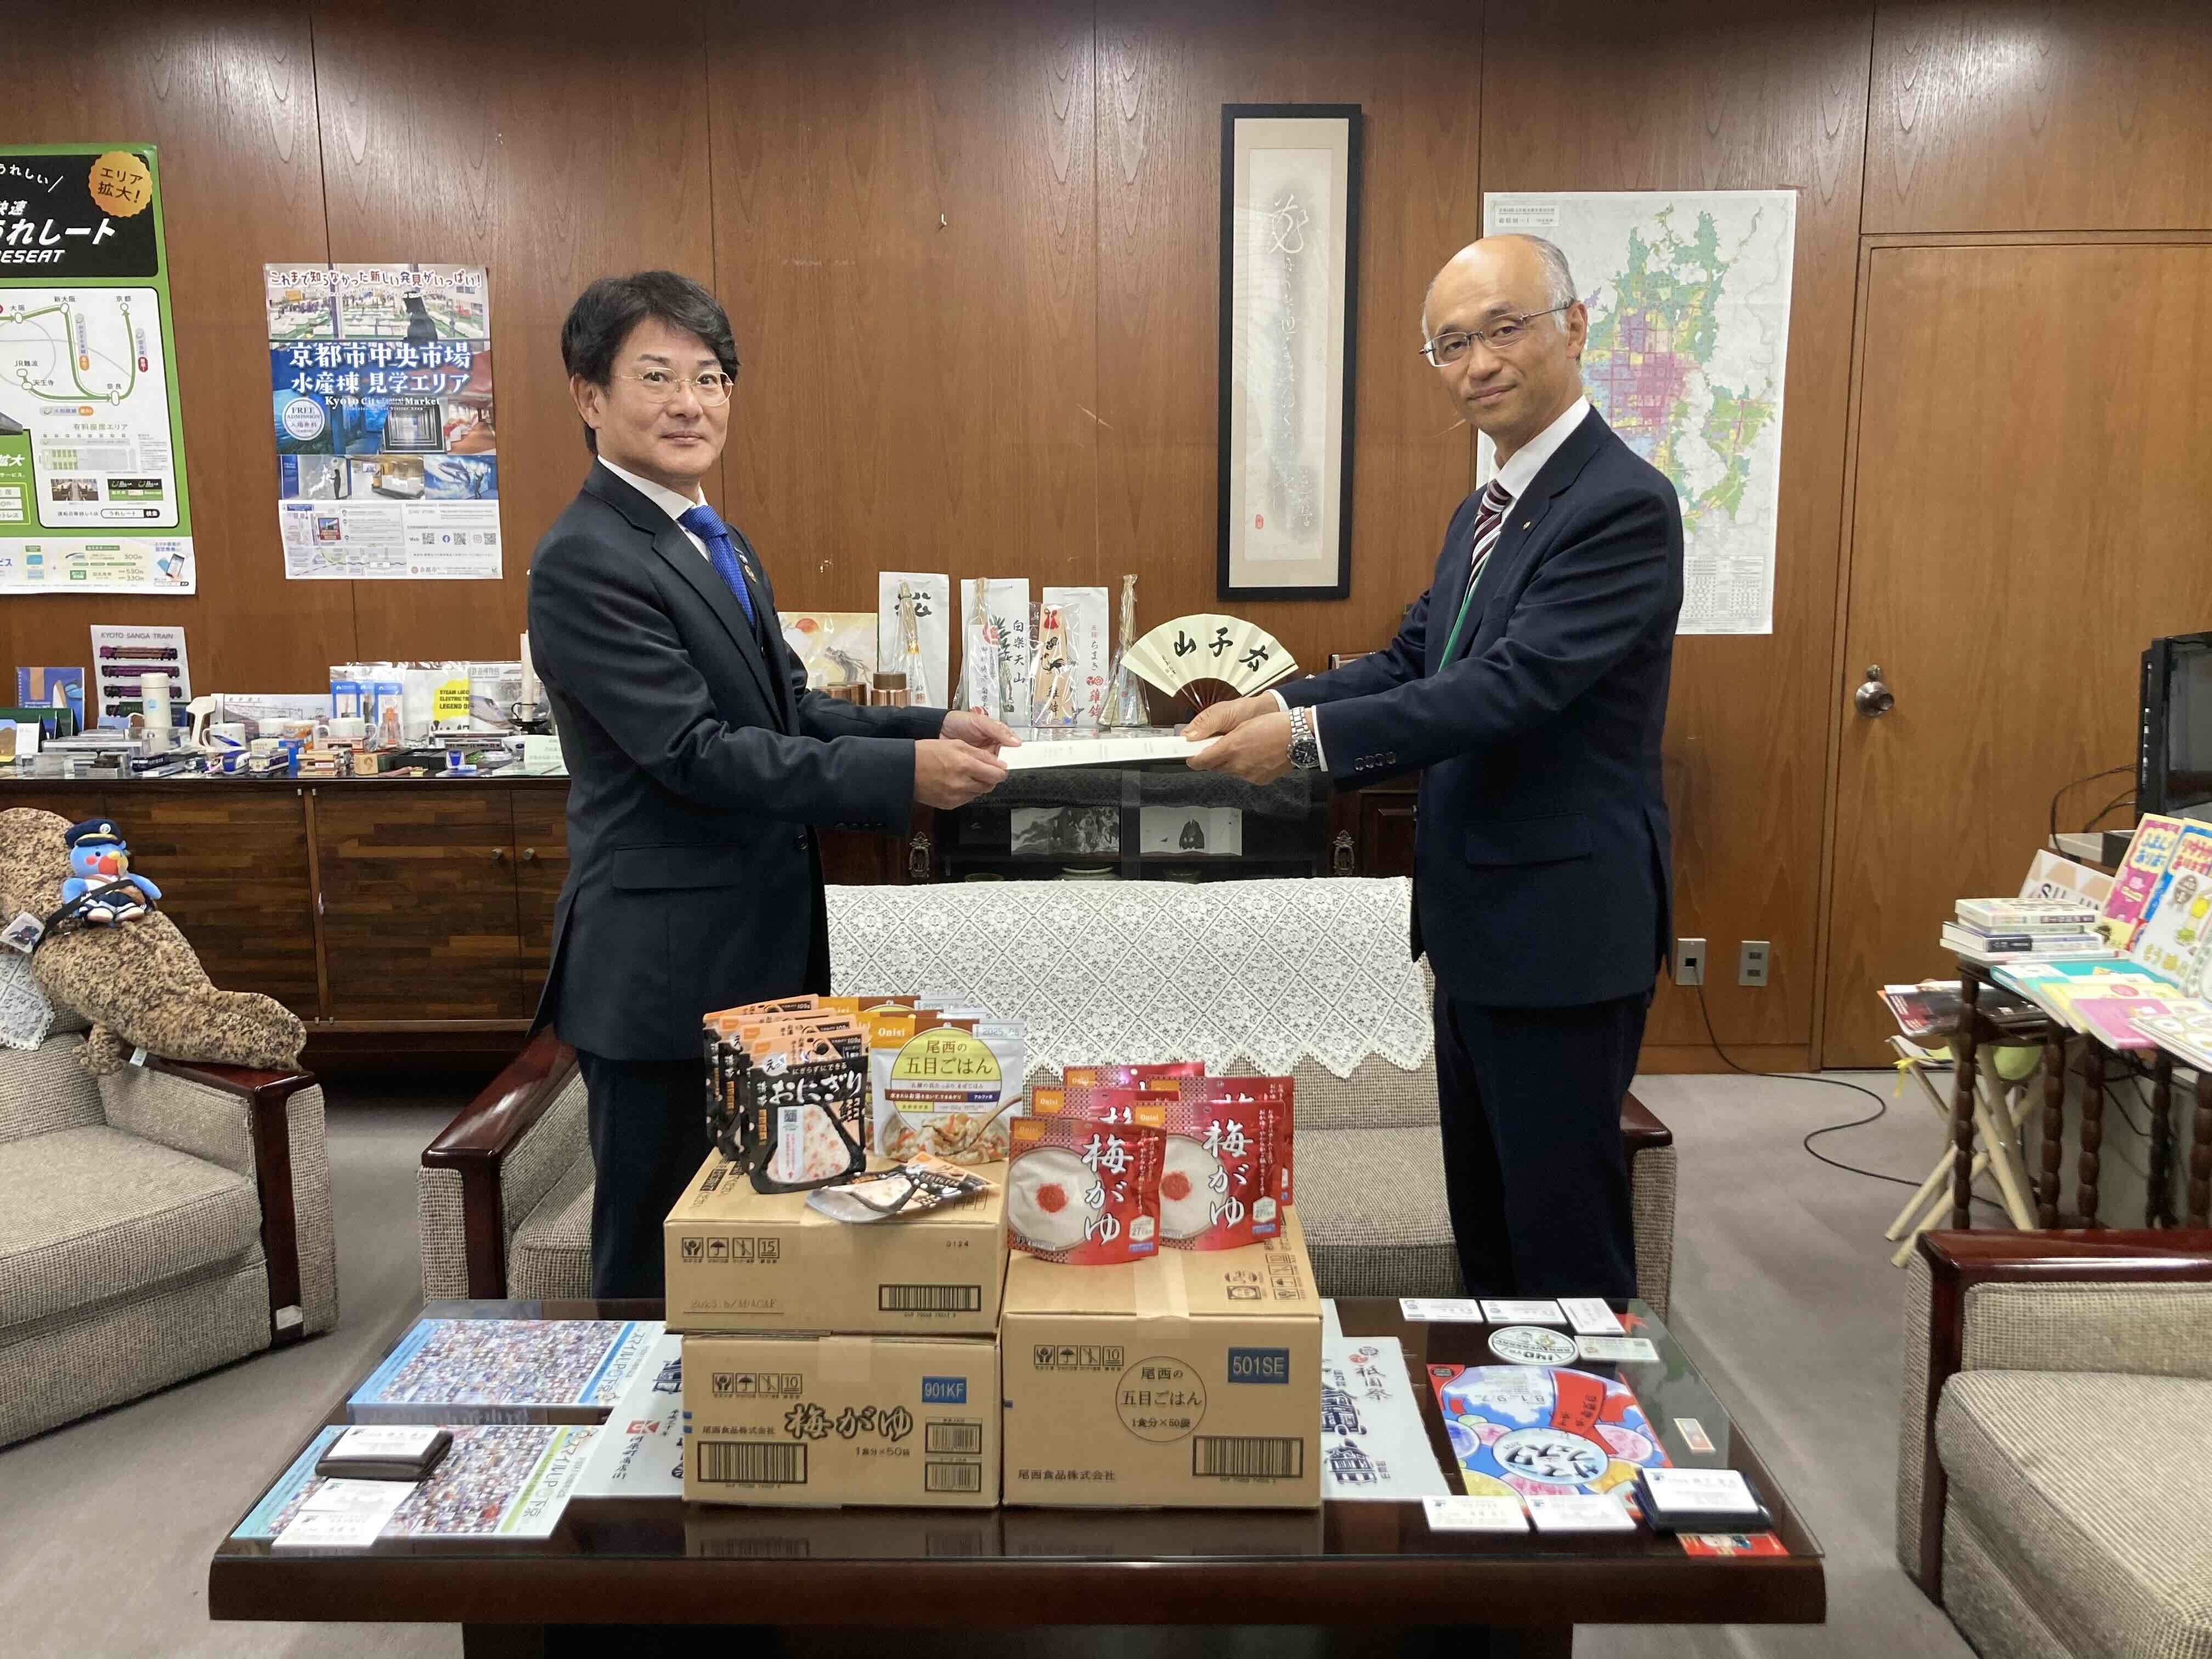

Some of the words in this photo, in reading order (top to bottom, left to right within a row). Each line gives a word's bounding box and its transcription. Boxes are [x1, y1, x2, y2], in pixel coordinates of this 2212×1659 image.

[100, 167, 143, 185] エリア
[0, 250, 66, 263] ESEAT
[289, 342, 471, 369] 京都市中央市場
[291, 373, 360, 394] 水産棟
[368, 373, 471, 394] 見学エリア
[325, 396, 359, 409] Kyoto
[361, 396, 381, 407] City
[405, 396, 440, 405] Market
[877, 1026, 905, 1036] Onisi
[926, 1040, 967, 1054] 尾西の
[904, 1057, 992, 1075] 五目ごはん
[769, 1070, 862, 1104] おにぎり
[1201, 1119, 1254, 1229] 梅がゆ
[1080, 1132, 1135, 1246] 梅がゆ
[761, 1241, 775, 1252] 15
[1106, 1348, 1120, 1360] 10
[1232, 1356, 1285, 1375] 501SE
[1141, 1367, 1183, 1380] 尾西の
[785, 1376, 799, 1387] 10
[924, 1383, 965, 1398] 901KF
[1122, 1390, 1203, 1406] 五目ごはん
[783, 1402, 914, 1443] 梅がゆ
[1018, 1469, 1116, 1481] 尾西食品株式会社
